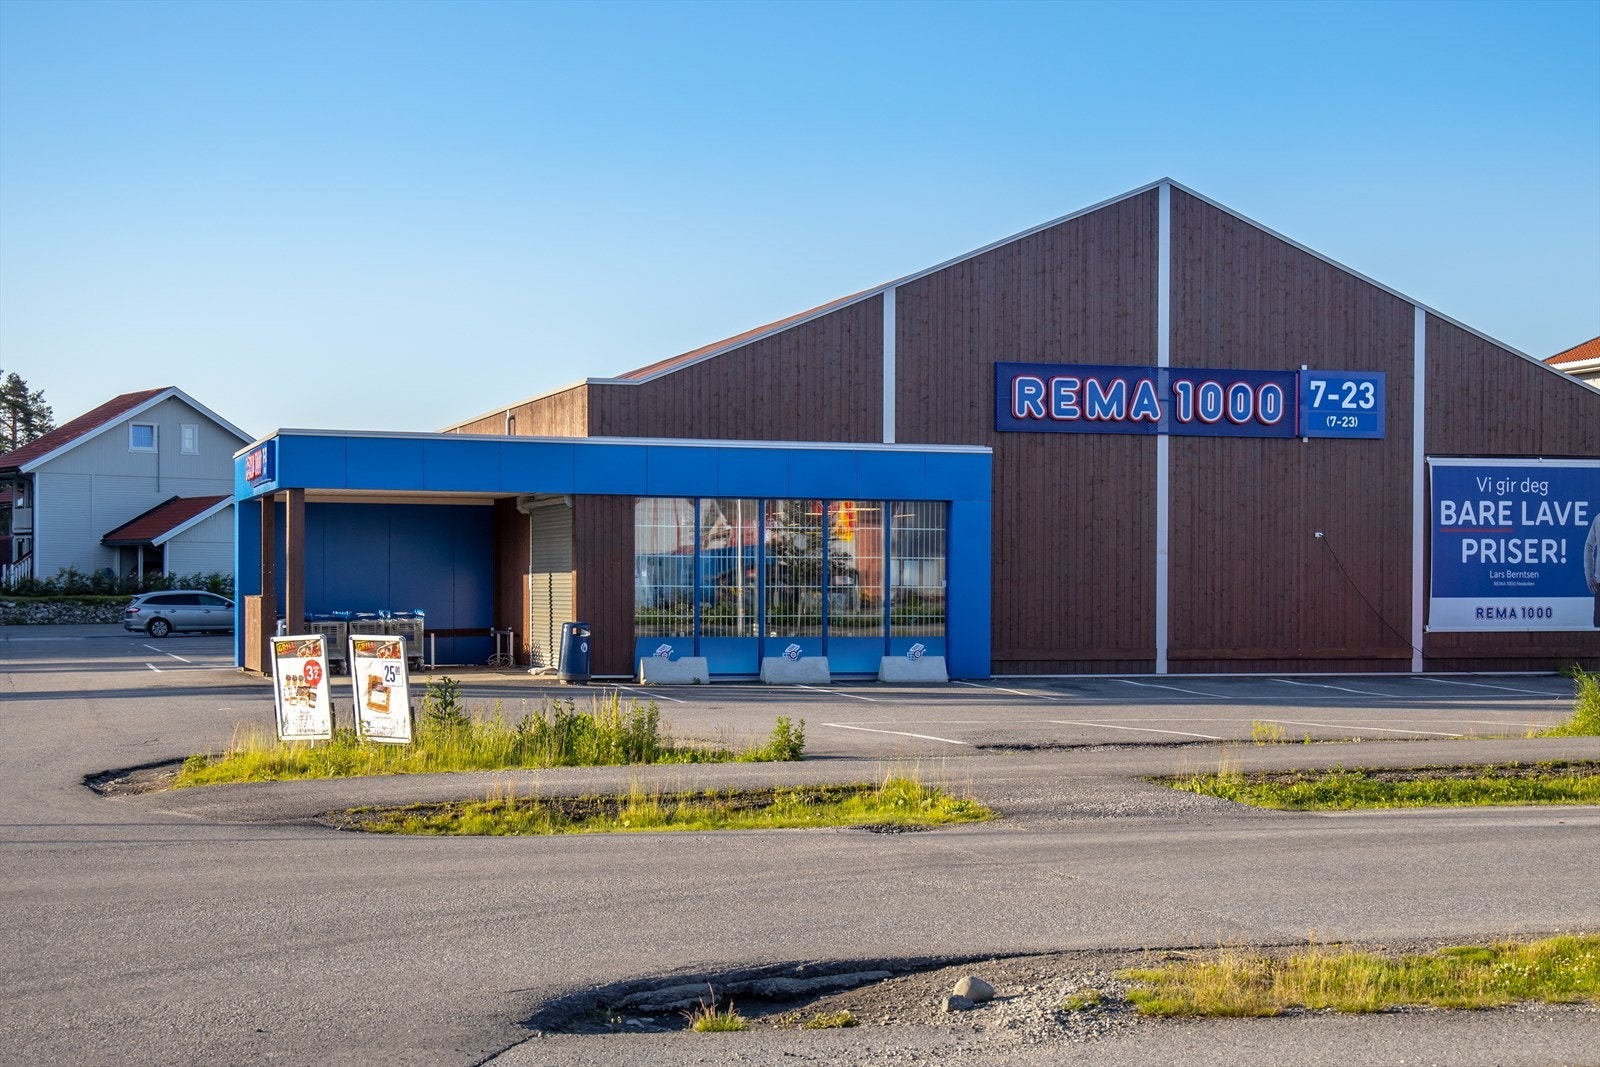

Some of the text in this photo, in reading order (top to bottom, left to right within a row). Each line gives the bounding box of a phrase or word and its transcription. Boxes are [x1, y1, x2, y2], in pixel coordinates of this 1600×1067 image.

[1012, 375, 1285, 425] REMA 1000
[1309, 381, 1375, 410] 7-23
[1326, 415, 1359, 429] (7-23)
[1476, 476, 1549, 496] Vi gir deg
[1440, 500, 1589, 526] BARE LAVE
[1461, 538, 1567, 564] PRISER!
[1489, 570, 1540, 579] Lars Berntsen
[1475, 607, 1553, 619] REMA 1000
